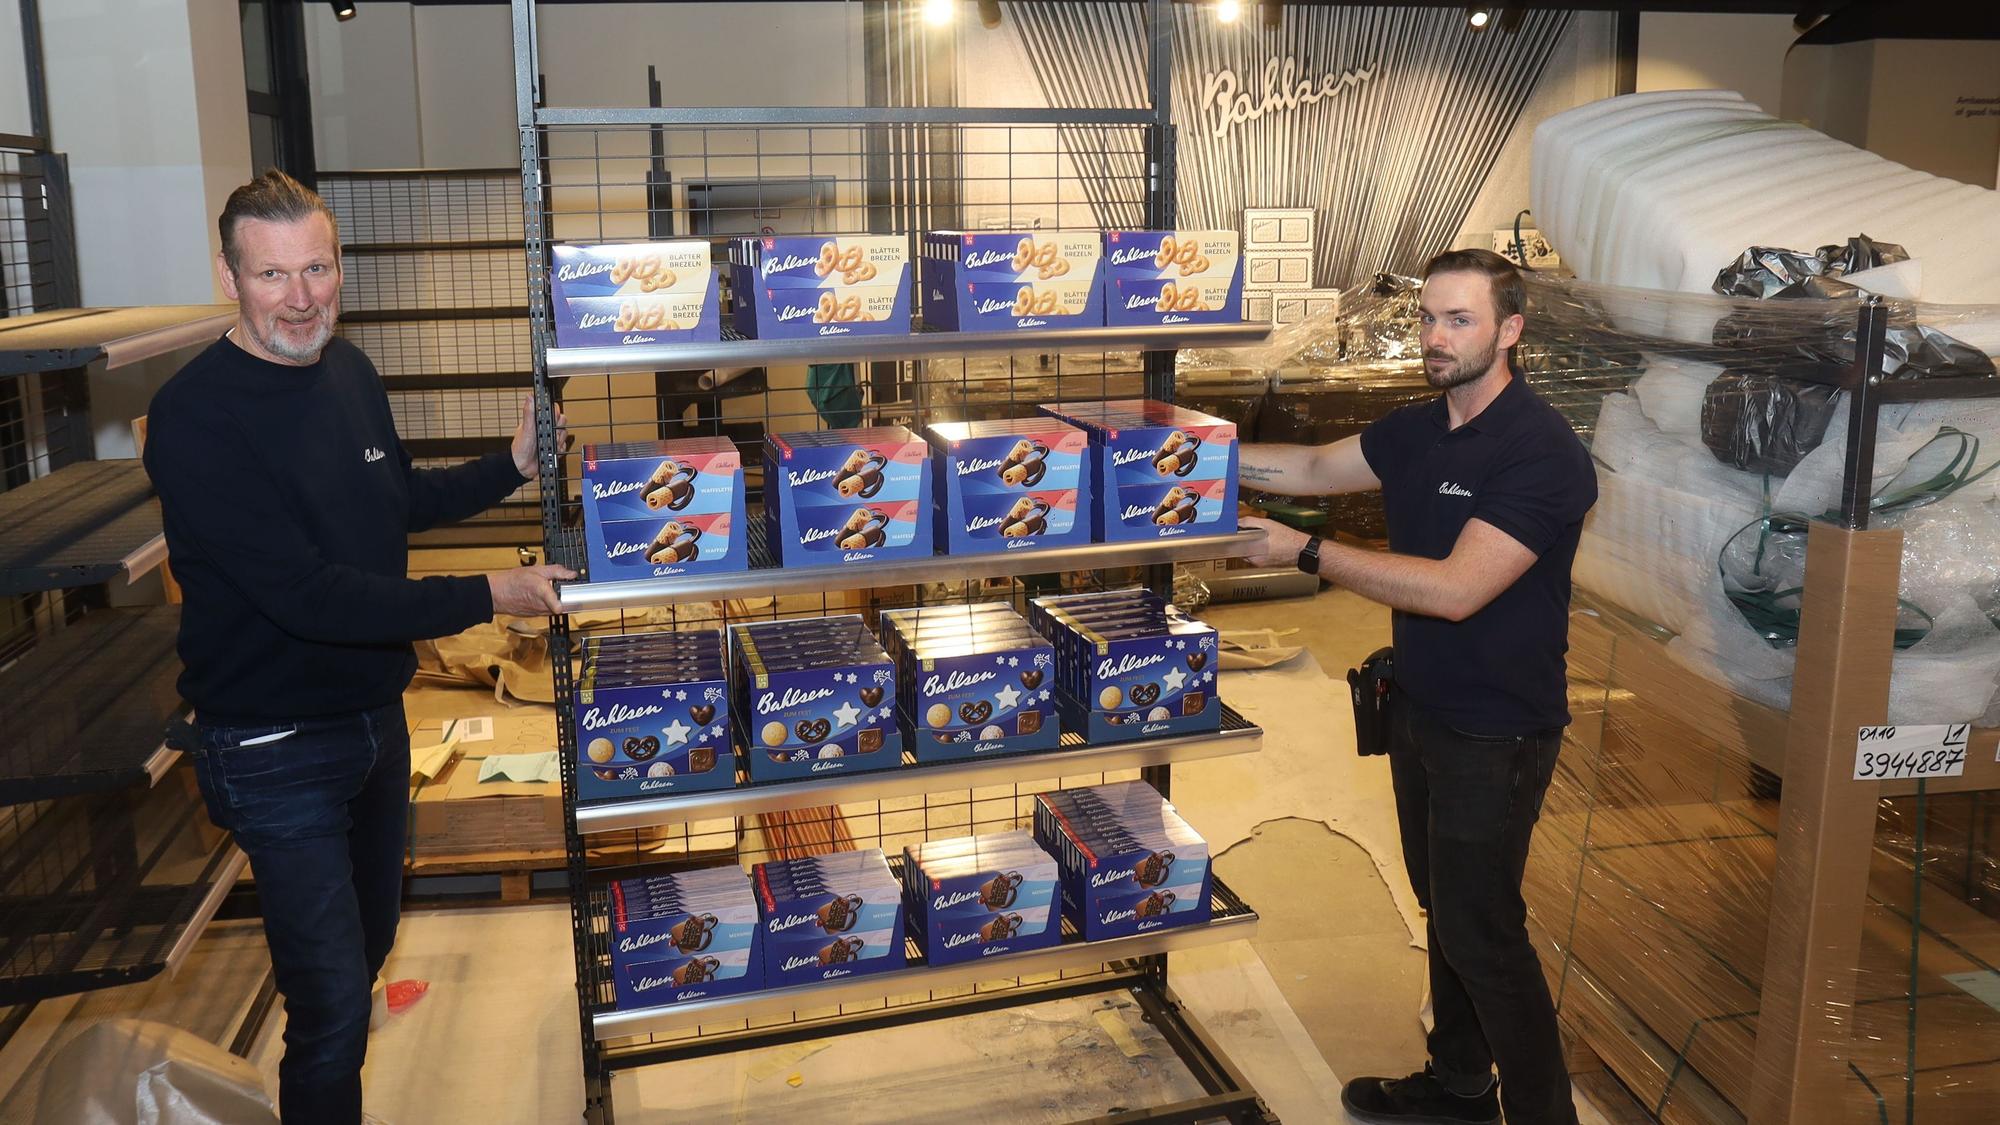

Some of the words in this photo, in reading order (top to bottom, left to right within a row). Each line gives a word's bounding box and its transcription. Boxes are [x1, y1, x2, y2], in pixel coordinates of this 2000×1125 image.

[1202, 55, 1376, 137] Bahlsen
[1204, 240, 1231, 248] BLÄTTER
[669, 253, 701, 261] BLÄTTER
[965, 250, 1017, 269] Bahlsen
[1111, 246, 1161, 265] Bahlsen
[558, 262, 616, 282] Bahlsen
[765, 254, 819, 275] Bahlsen
[868, 296, 893, 304] BLÄTTE
[1063, 290, 1089, 298] BLÄTTE
[1123, 294, 1161, 310] hlsen
[774, 305, 818, 322] hlsen
[974, 298, 1018, 315] hlsen
[575, 313, 619, 330] hlsen
[672, 311, 701, 319] BREZEL
[1017, 318, 1047, 328] Bahlsen
[1162, 314, 1190, 324] Bahlsen
[819, 326, 850, 336] Bahlsen
[622, 335, 656, 345] Bahlsen
[1113, 449, 1156, 467] Bahlsen
[956, 458, 1002, 476] Bahlsen
[788, 468, 838, 488] Bahlsen
[592, 480, 644, 500] Bahlsen
[1159, 527, 1186, 537] Bahlsen
[1007, 539, 1036, 549] Bahlsen
[843, 552, 875, 562] Bahlsen
[653, 566, 686, 577] Bahlsen
[1097, 653, 1165, 680] Bahlsen
[923, 670, 997, 697] Bahlsen
[757, 687, 834, 715] Bahlsen
[582, 703, 663, 731] Bahlsen
[1141, 724, 1170, 733] Bahlsen
[1860, 726, 1895, 741] 01.10
[974, 743, 1005, 753] Bahlsen
[811, 761, 844, 772] Bahlsen
[1858, 748, 1964, 777] 3944887
[640, 780, 674, 791] Bahlsen
[1091, 867, 1136, 888] Bahlsen
[933, 890, 981, 911] Bahlsen
[769, 913, 819, 933] Bahlsen
[1100, 909, 1136, 925] hlsen
[1137, 921, 1163, 931] Bahlsen
[619, 932, 672, 952] Bahlsen
[942, 931, 981, 948] hlsen
[983, 946, 1010, 956] Bahlsen
[780, 955, 819, 971] hlsen
[823, 969, 852, 979] Bahlsen
[631, 975, 675, 992] hlsen
[676, 990, 707, 1001] Bahlsen
